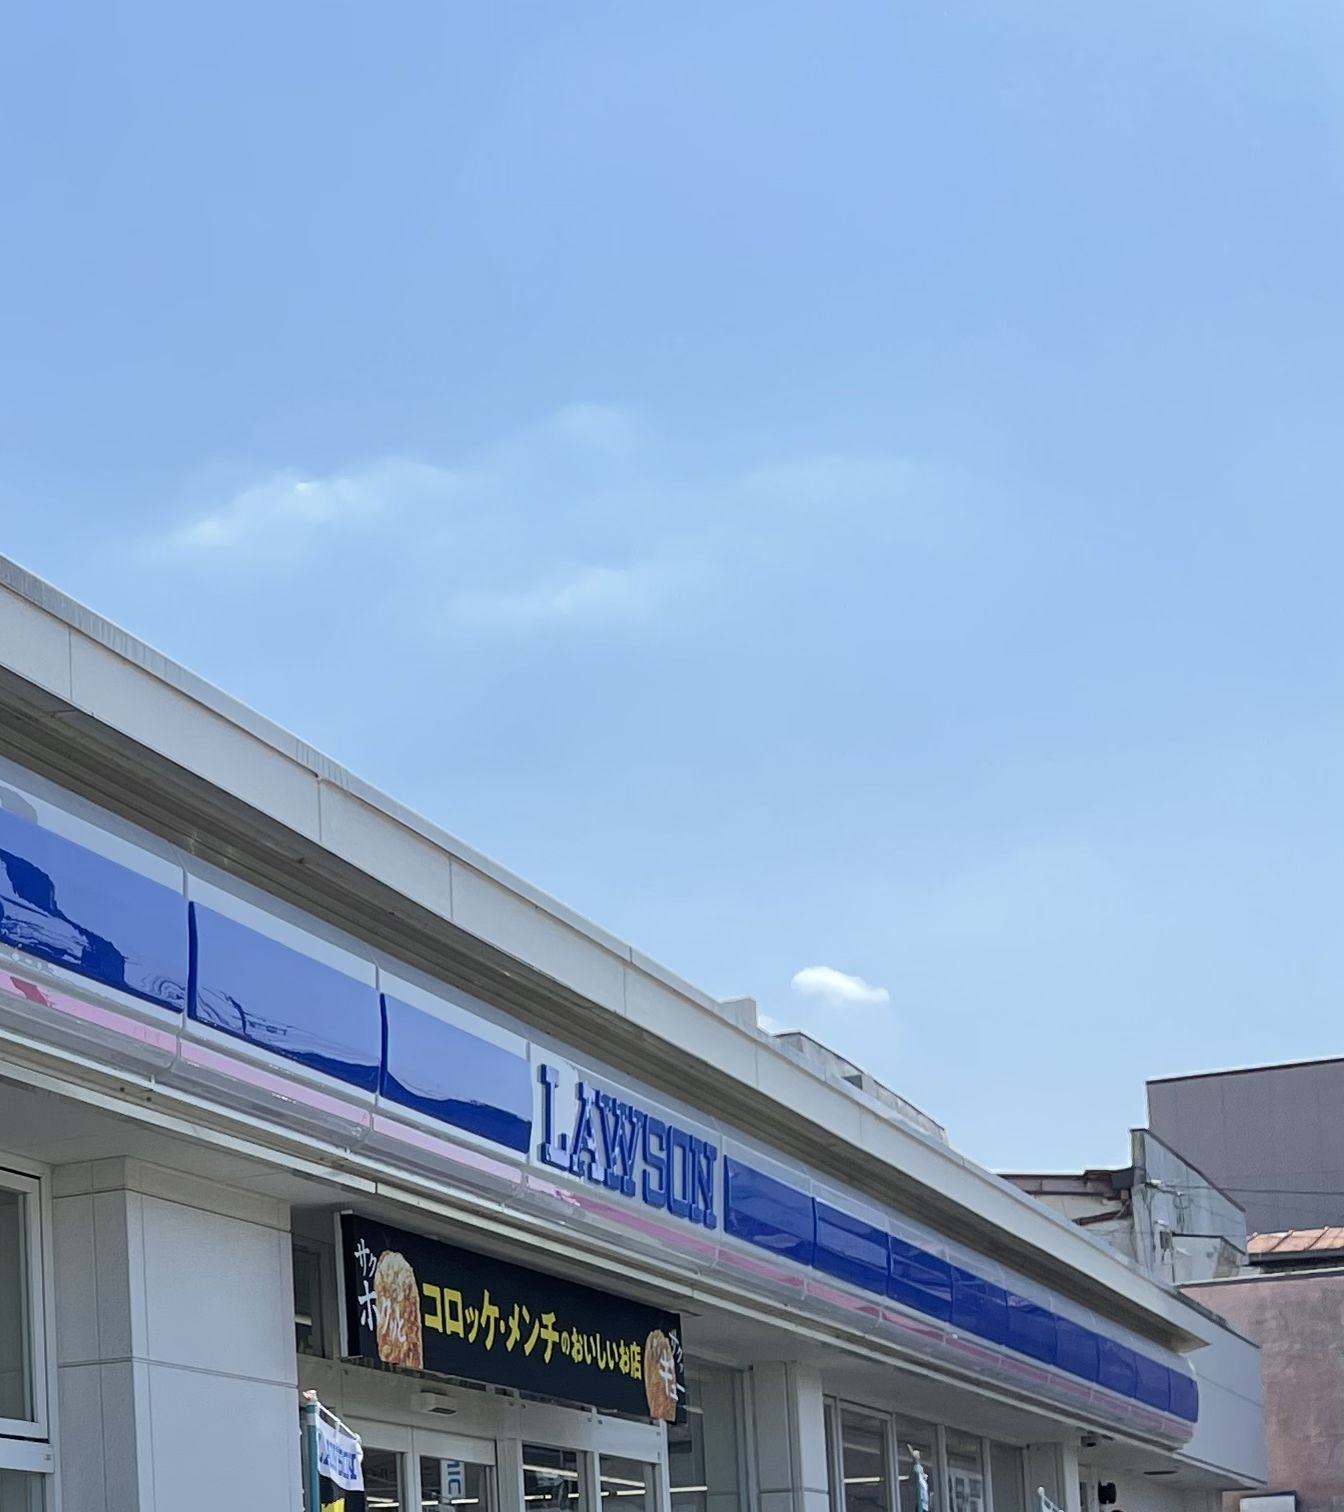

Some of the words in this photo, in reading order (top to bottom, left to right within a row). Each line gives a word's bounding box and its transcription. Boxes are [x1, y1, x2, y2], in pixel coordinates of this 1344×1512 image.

[537, 1063, 718, 1229] LAWSON
[422, 1282, 642, 1381] コロッケ・メンチのおいしいお店
